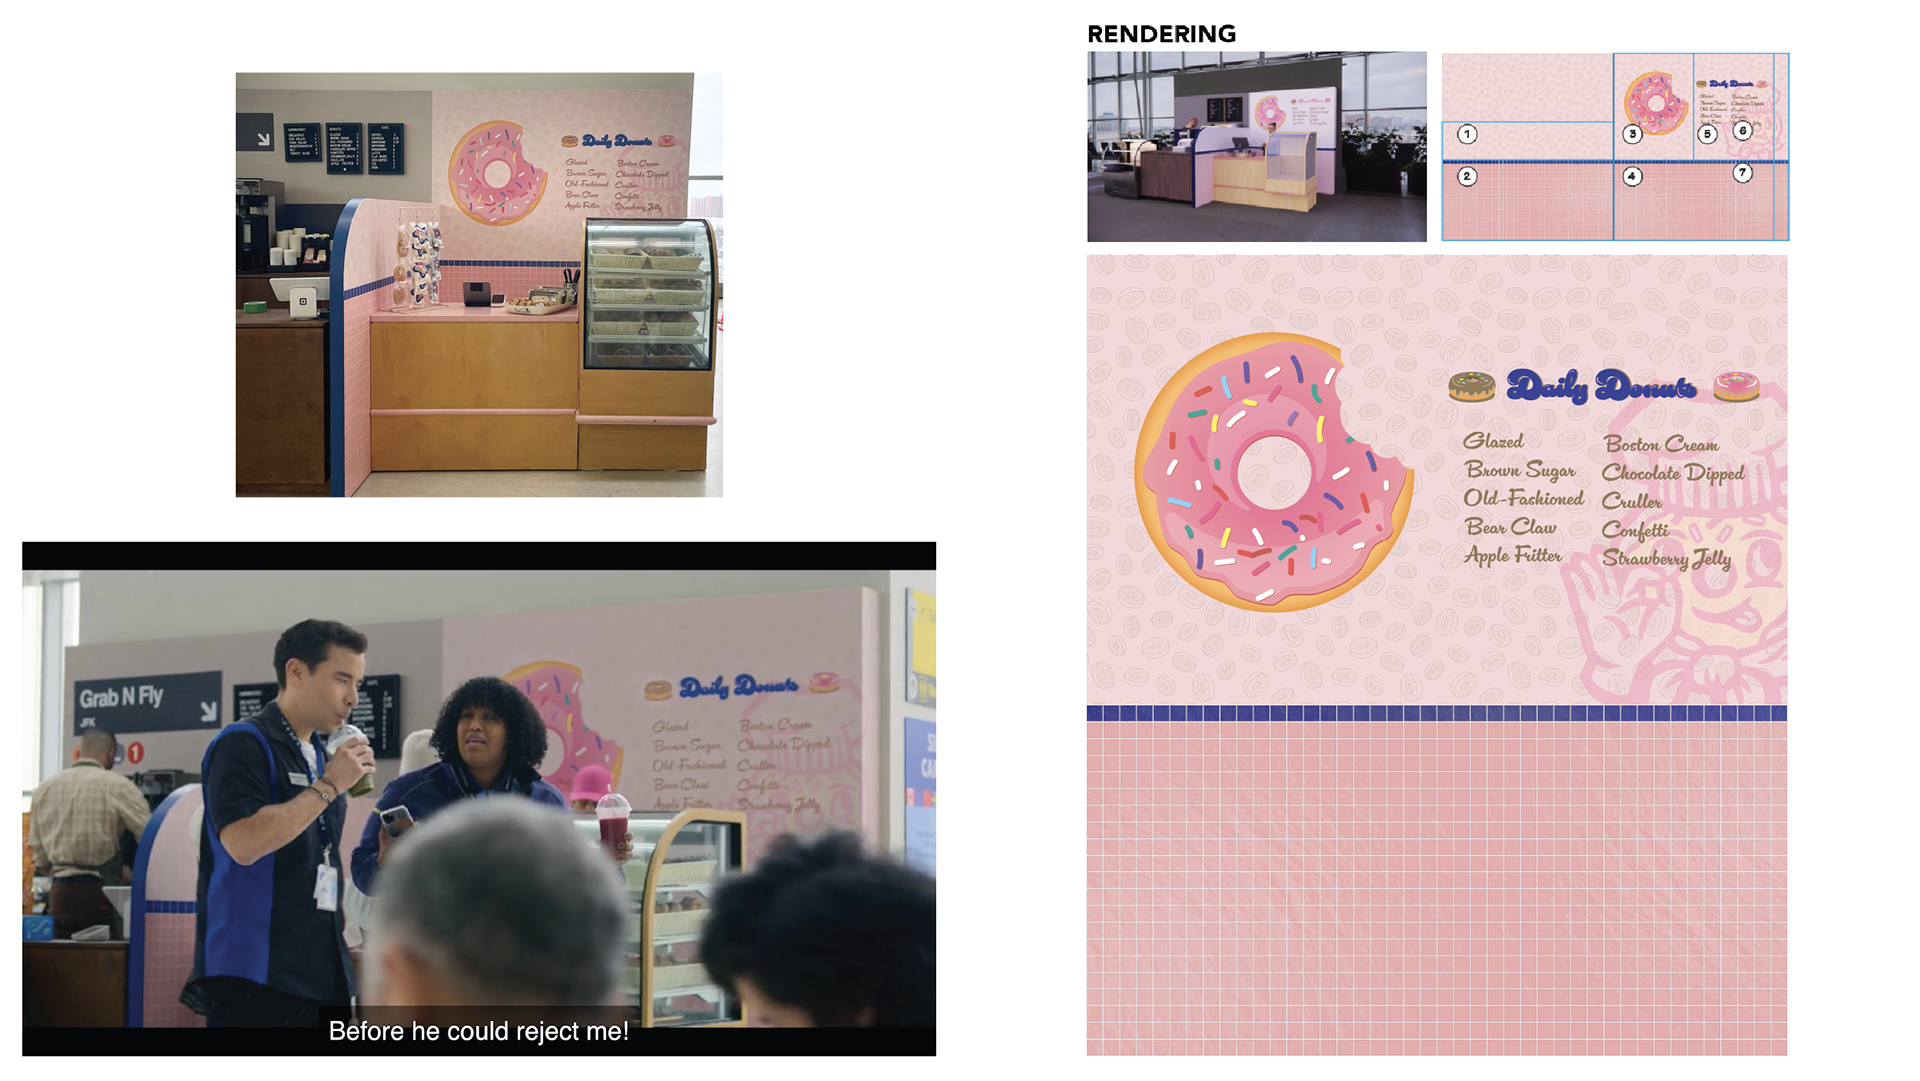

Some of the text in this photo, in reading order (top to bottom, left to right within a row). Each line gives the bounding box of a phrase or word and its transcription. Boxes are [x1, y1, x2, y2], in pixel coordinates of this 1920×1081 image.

[582, 134, 652, 148] Daily Donuts
[565, 158, 588, 166] Glazed
[566, 169, 606, 178] Brown Sugar
[615, 170, 669, 179] Chocolate Dipped
[615, 181, 637, 189] Cruller
[615, 192, 640, 201] Confetti
[565, 201, 600, 211] Apple Fritter
[647, 203, 662, 212] Jelly
[1506, 368, 1697, 405] Daily Donuts
[1463, 432, 1524, 450] Glazed
[1604, 434, 1720, 453] Boston Cream
[1465, 460, 1576, 483] Brown Sugar
[1602, 463, 1746, 486] Chocolate Dipped
[1463, 488, 1585, 507] Old-Fashioned
[1602, 492, 1663, 510] Cruller
[1465, 517, 1556, 535] Bear Claw
[1602, 520, 1670, 543] Confetti
[1464, 545, 1562, 568] Apple Fritter
[1602, 548, 1732, 572] Strawberry Jelly
[679, 673, 799, 699] Daily Donuts
[79, 684, 164, 709] Grab N Fly
[80, 717, 96, 728] JFK
[132, 745, 138, 760] 1
[690, 739, 722, 754] Sugar
[791, 738, 830, 754] Dipped
